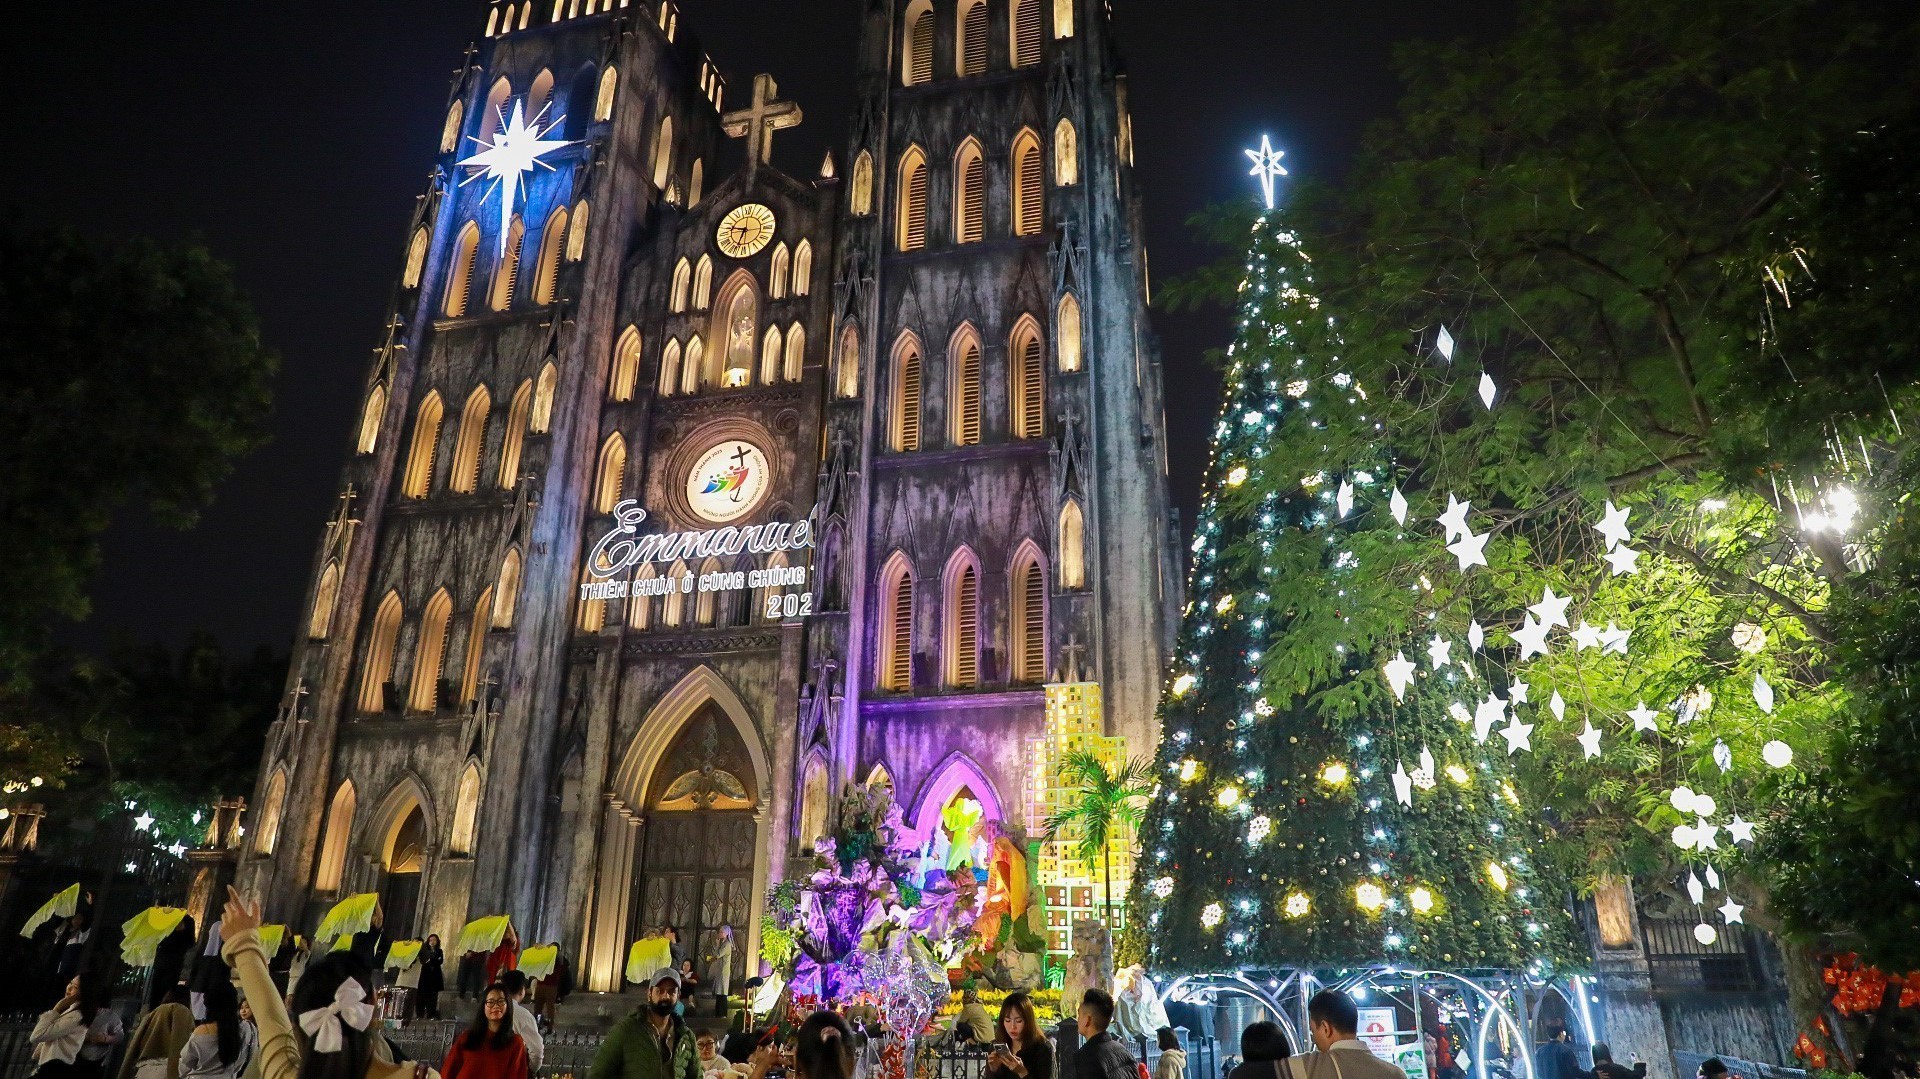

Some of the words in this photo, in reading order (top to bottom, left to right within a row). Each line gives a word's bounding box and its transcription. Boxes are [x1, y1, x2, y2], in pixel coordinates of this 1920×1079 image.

[580, 578, 628, 600] THIÊN
[632, 574, 676, 597] CHÚA
[698, 571, 745, 592] CÙNG
[748, 565, 806, 588] CHÚNG
[767, 592, 813, 618] 202
